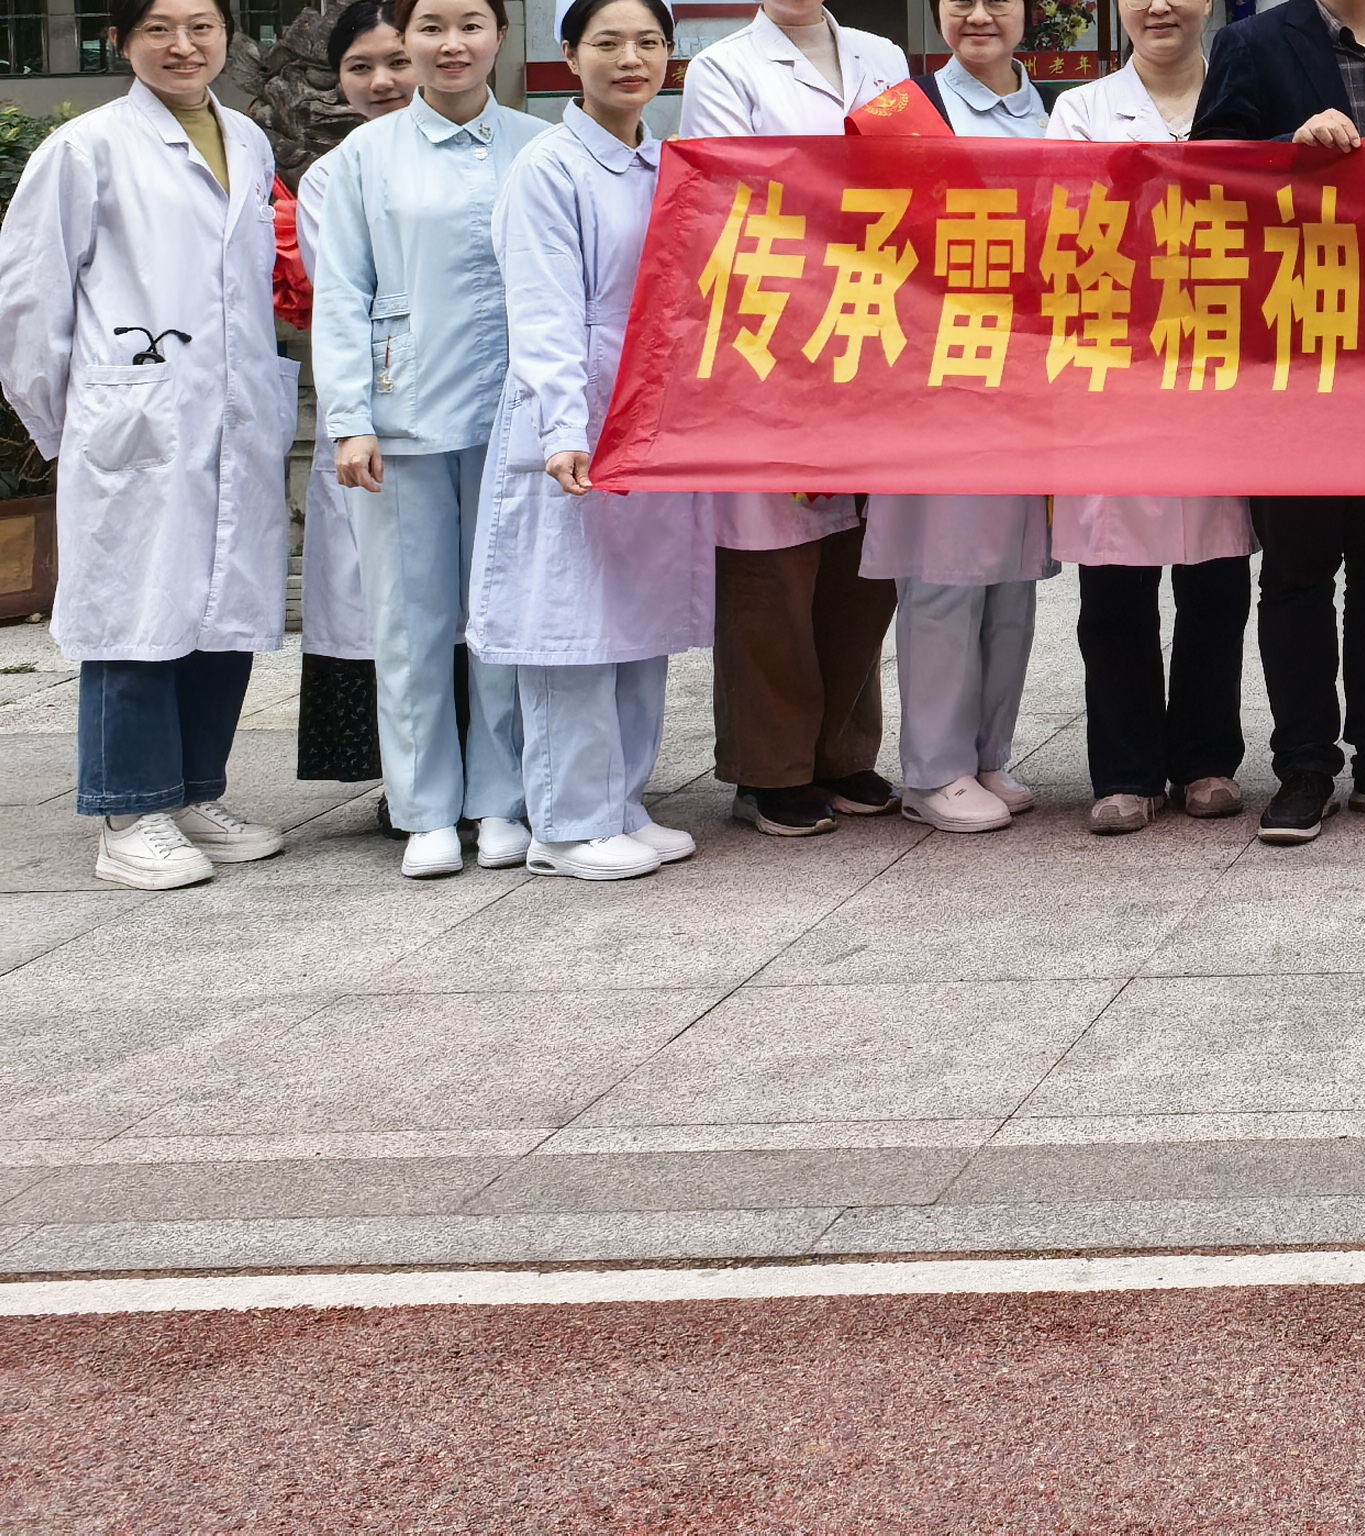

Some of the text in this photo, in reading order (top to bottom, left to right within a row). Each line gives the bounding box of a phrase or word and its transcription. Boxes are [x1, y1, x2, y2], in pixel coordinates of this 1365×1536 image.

[695, 178, 1361, 393] 传承雷锋精神
